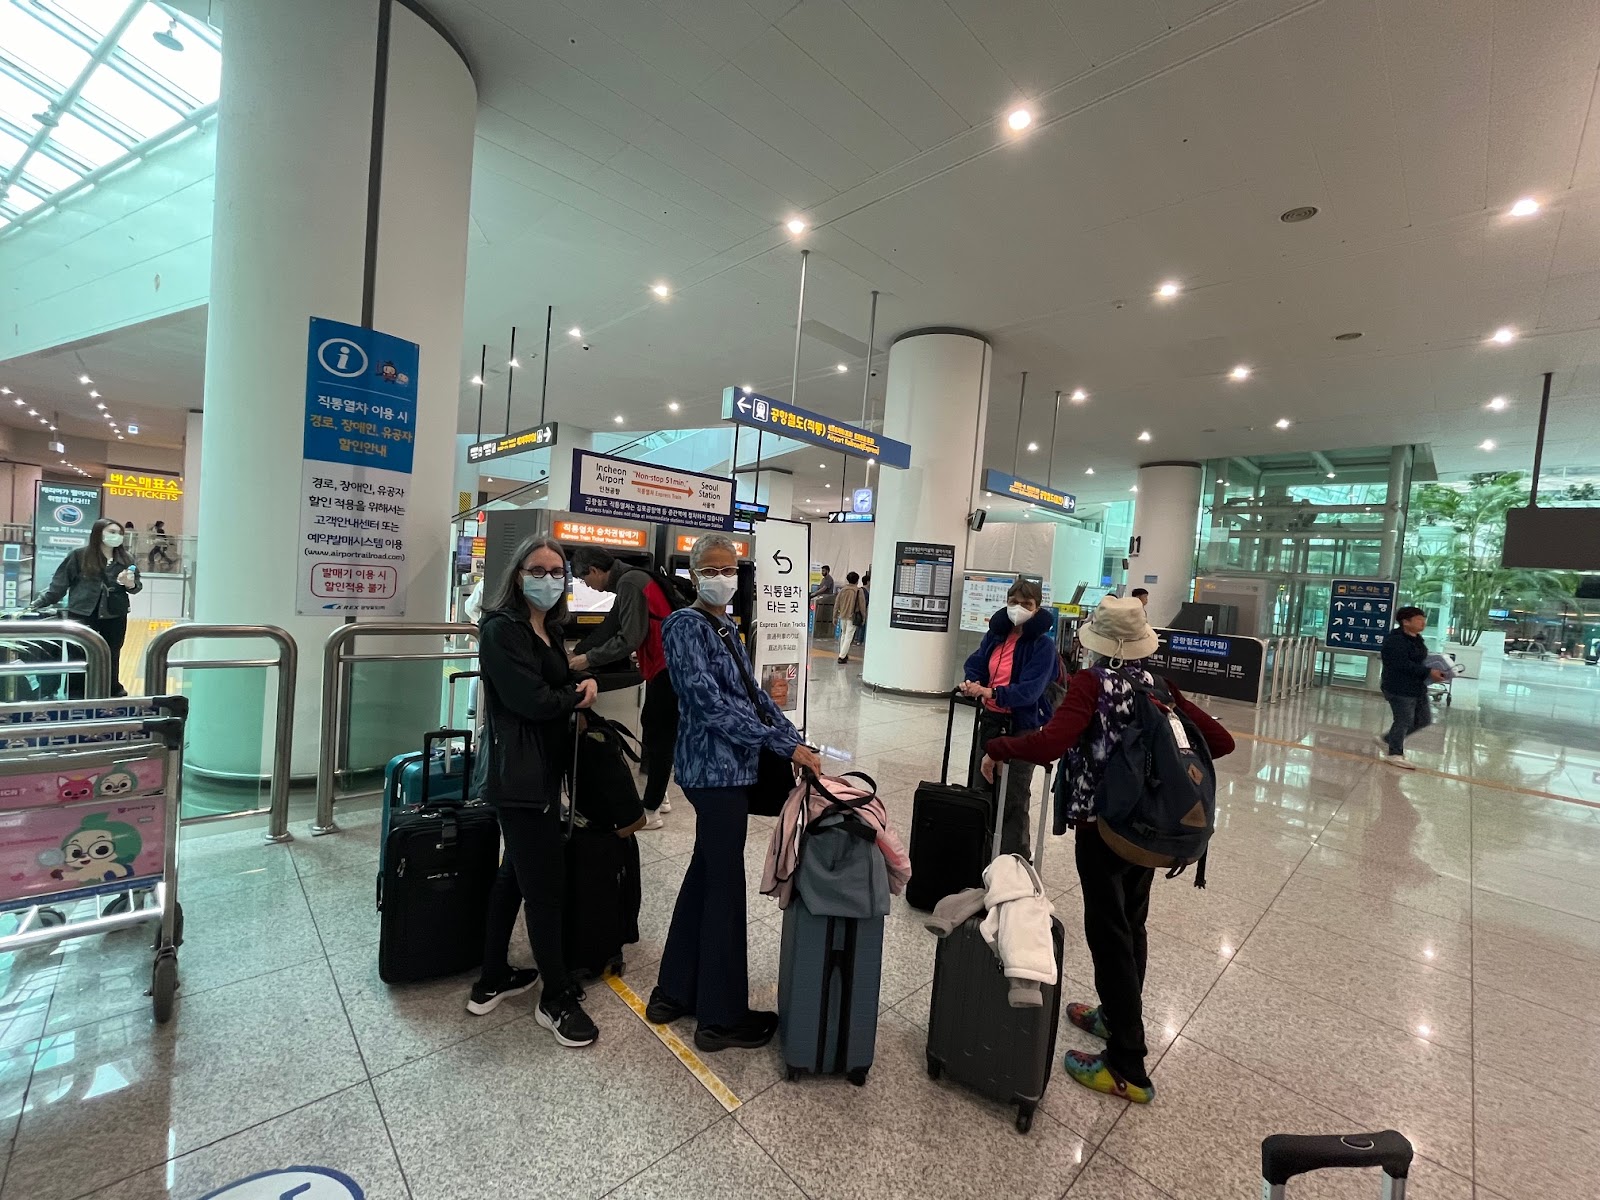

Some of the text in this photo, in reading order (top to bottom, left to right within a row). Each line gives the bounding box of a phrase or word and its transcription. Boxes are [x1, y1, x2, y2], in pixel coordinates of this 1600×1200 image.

[318, 395, 408, 423] 직통열차 이용 시
[771, 407, 827, 437] 공항철도(직통)
[381, 426, 413, 443] 유공자
[339, 437, 387, 457] 할인안내
[596, 463, 627, 476] Incheon
[110, 473, 178, 491] 버스매표소
[596, 473, 624, 486] Airport
[701, 481, 719, 491] Seoul
[312, 477, 404, 497] 경로, 장애인, 유공자
[599, 485, 620, 495] 인천공항
[110, 488, 178, 501] BUS TICKETS
[699, 490, 721, 501] Station
[309, 495, 406, 516] 할인 적용을 위해서는
[585, 497, 608, 507] 공항철도
[314, 515, 400, 532] 고객안내센터 또는
[563, 523, 639, 539] 직통열차 승차권발매기
[307, 533, 403, 550] 예약발매시스템 이용
[304, 548, 405, 561] (www.airportrailroad.com)
[322, 568, 386, 580] 발매기 이용 시
[325, 581, 386, 593] 할인적용 불가
[763, 585, 802, 598] 직통열차
[767, 601, 800, 614] 타는 곳
[1172, 636, 1228, 650] 공항철도(지하철)
